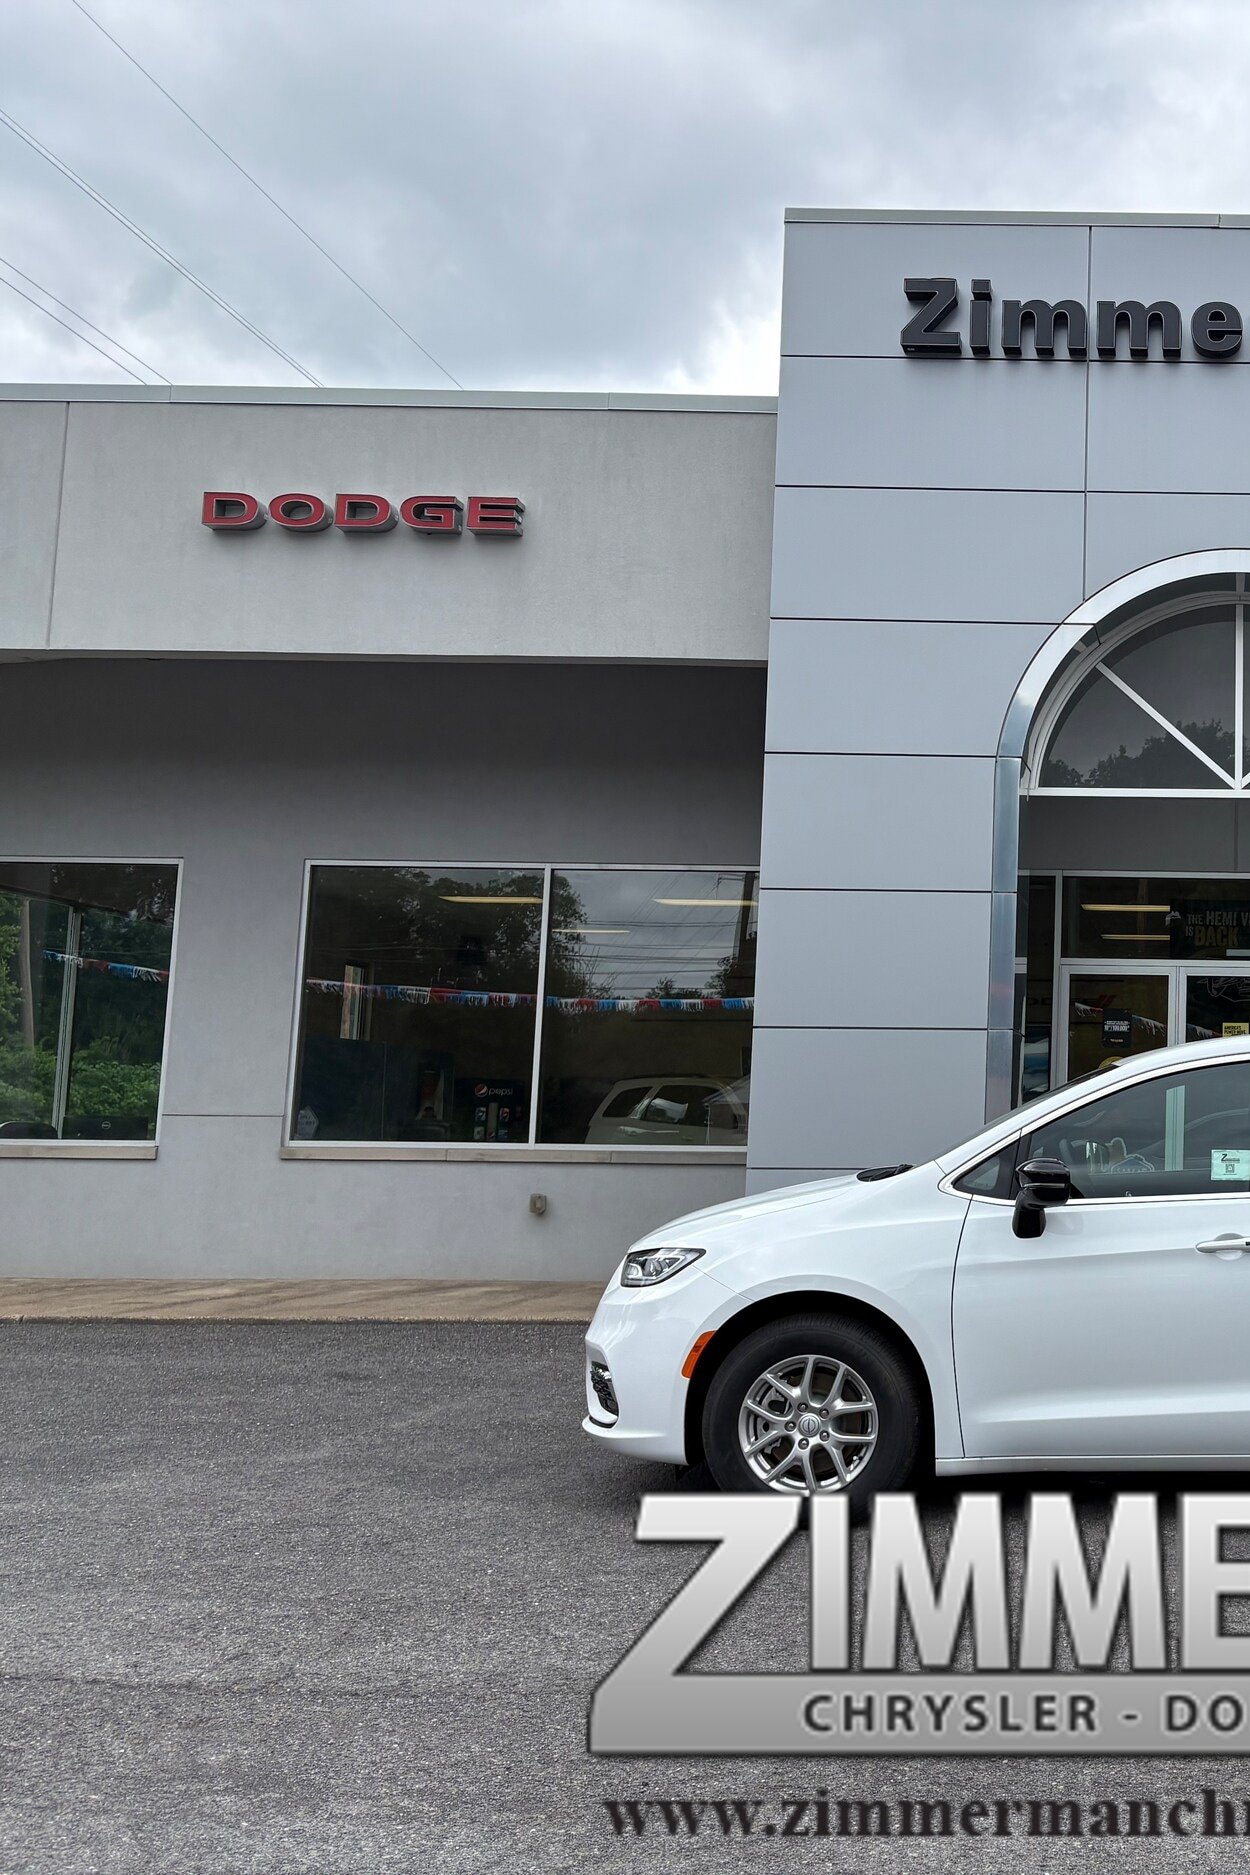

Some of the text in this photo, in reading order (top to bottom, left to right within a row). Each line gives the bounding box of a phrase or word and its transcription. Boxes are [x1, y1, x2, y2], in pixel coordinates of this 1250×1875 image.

[202, 491, 526, 536] DODGE
[1187, 913, 1204, 925] THE
[1206, 911, 1237, 926] HEMI
[1185, 926, 1239, 946] IS BACK
[488, 1087, 514, 1097] pepsi
